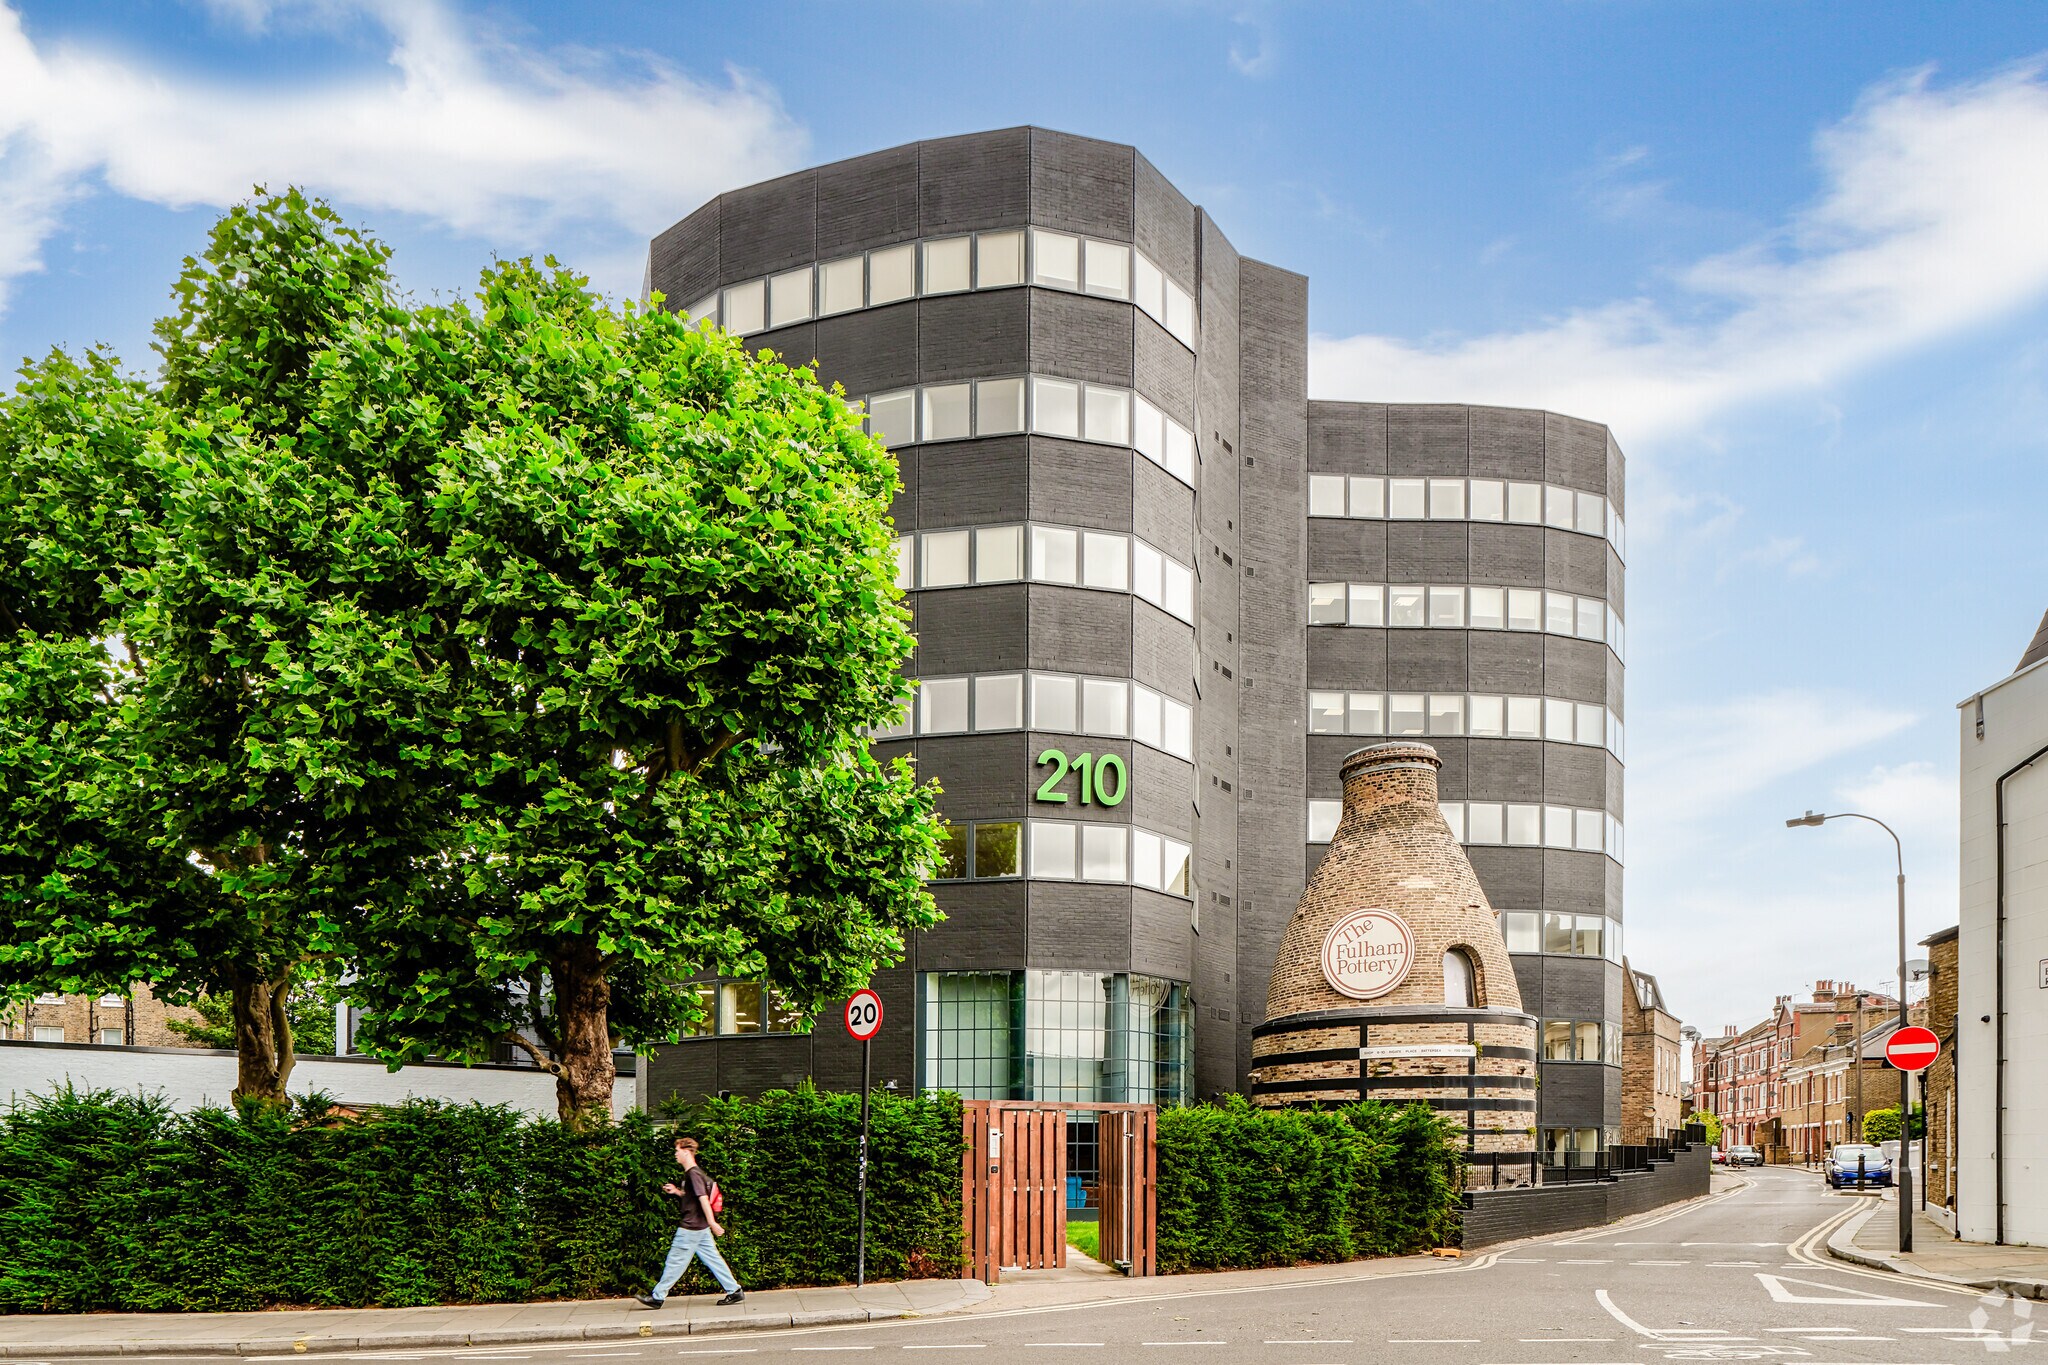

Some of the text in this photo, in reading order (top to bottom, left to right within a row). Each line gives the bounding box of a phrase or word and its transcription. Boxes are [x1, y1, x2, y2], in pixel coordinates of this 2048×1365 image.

[1036, 749, 1127, 806] 210
[1338, 919, 1374, 944] The
[1336, 941, 1404, 959] Fulham
[1337, 958, 1398, 975] Pottery
[850, 1003, 876, 1026] 20
